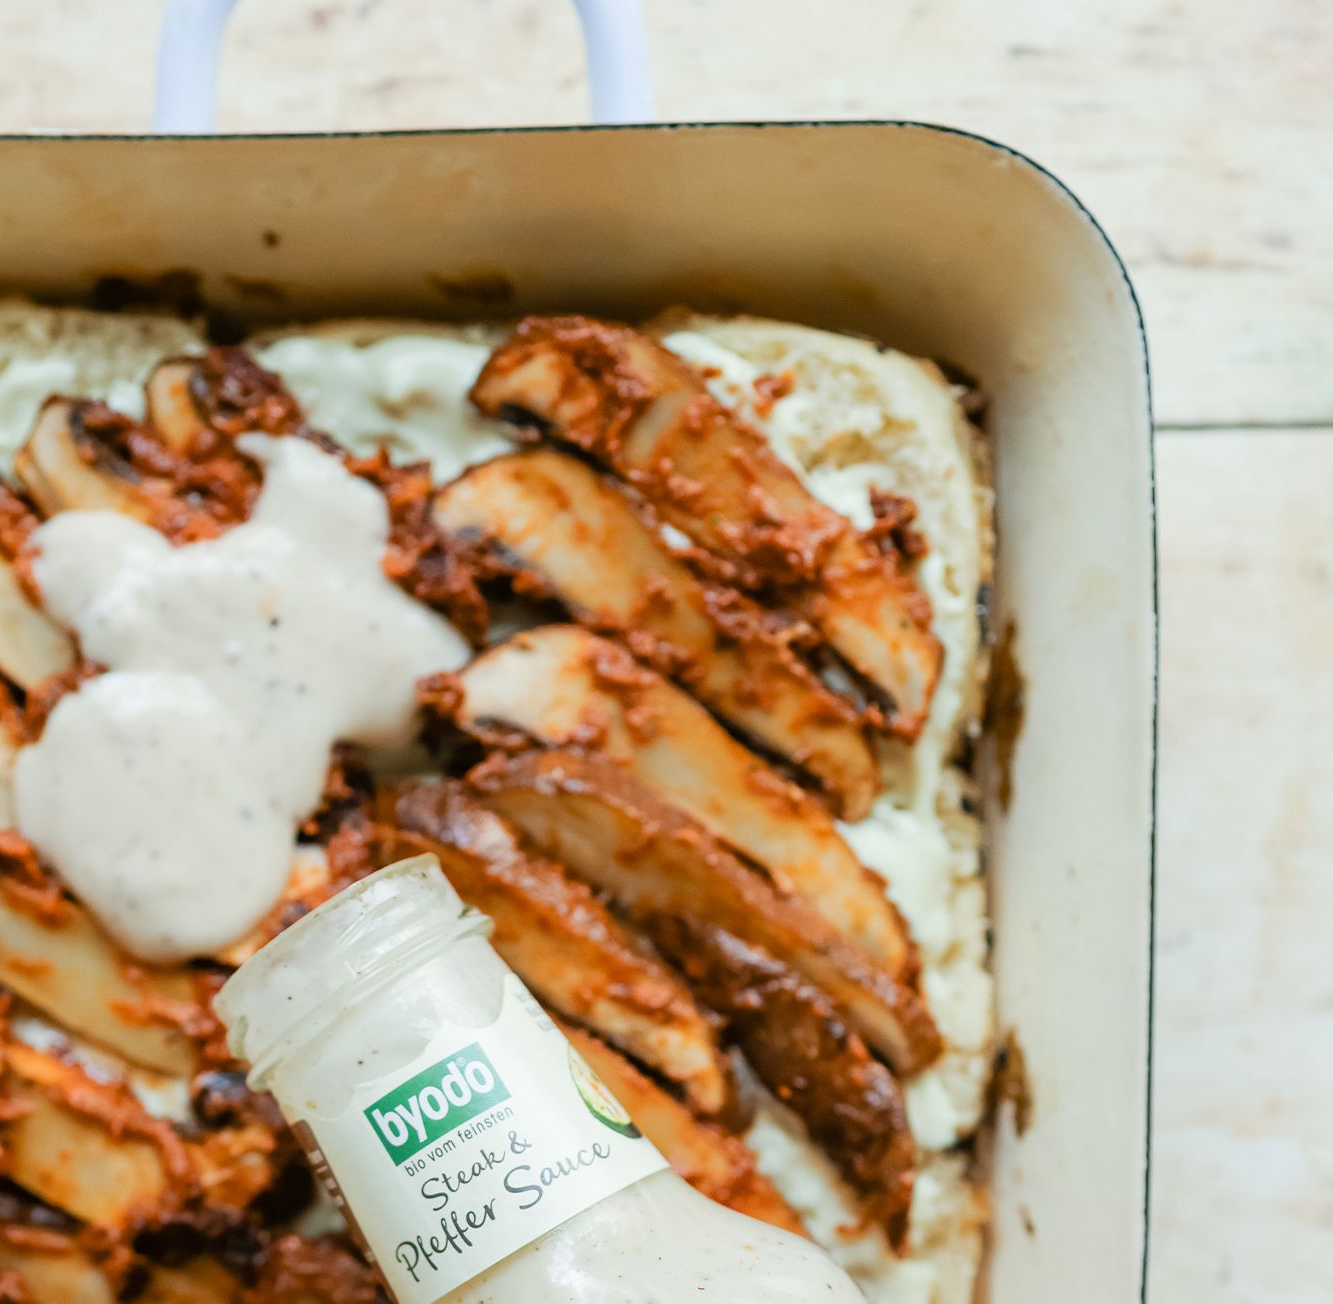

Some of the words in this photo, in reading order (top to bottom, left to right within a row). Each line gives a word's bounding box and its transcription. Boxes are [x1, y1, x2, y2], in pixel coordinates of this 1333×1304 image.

[404, 1159, 426, 1177] bio
[428, 1139, 457, 1162] vom
[457, 1105, 514, 1144] feinsten
[421, 1149, 506, 1211] Steak
[510, 1130, 532, 1154] &
[395, 1198, 497, 1282] Pfeffer
[503, 1140, 611, 1210] Sauce
